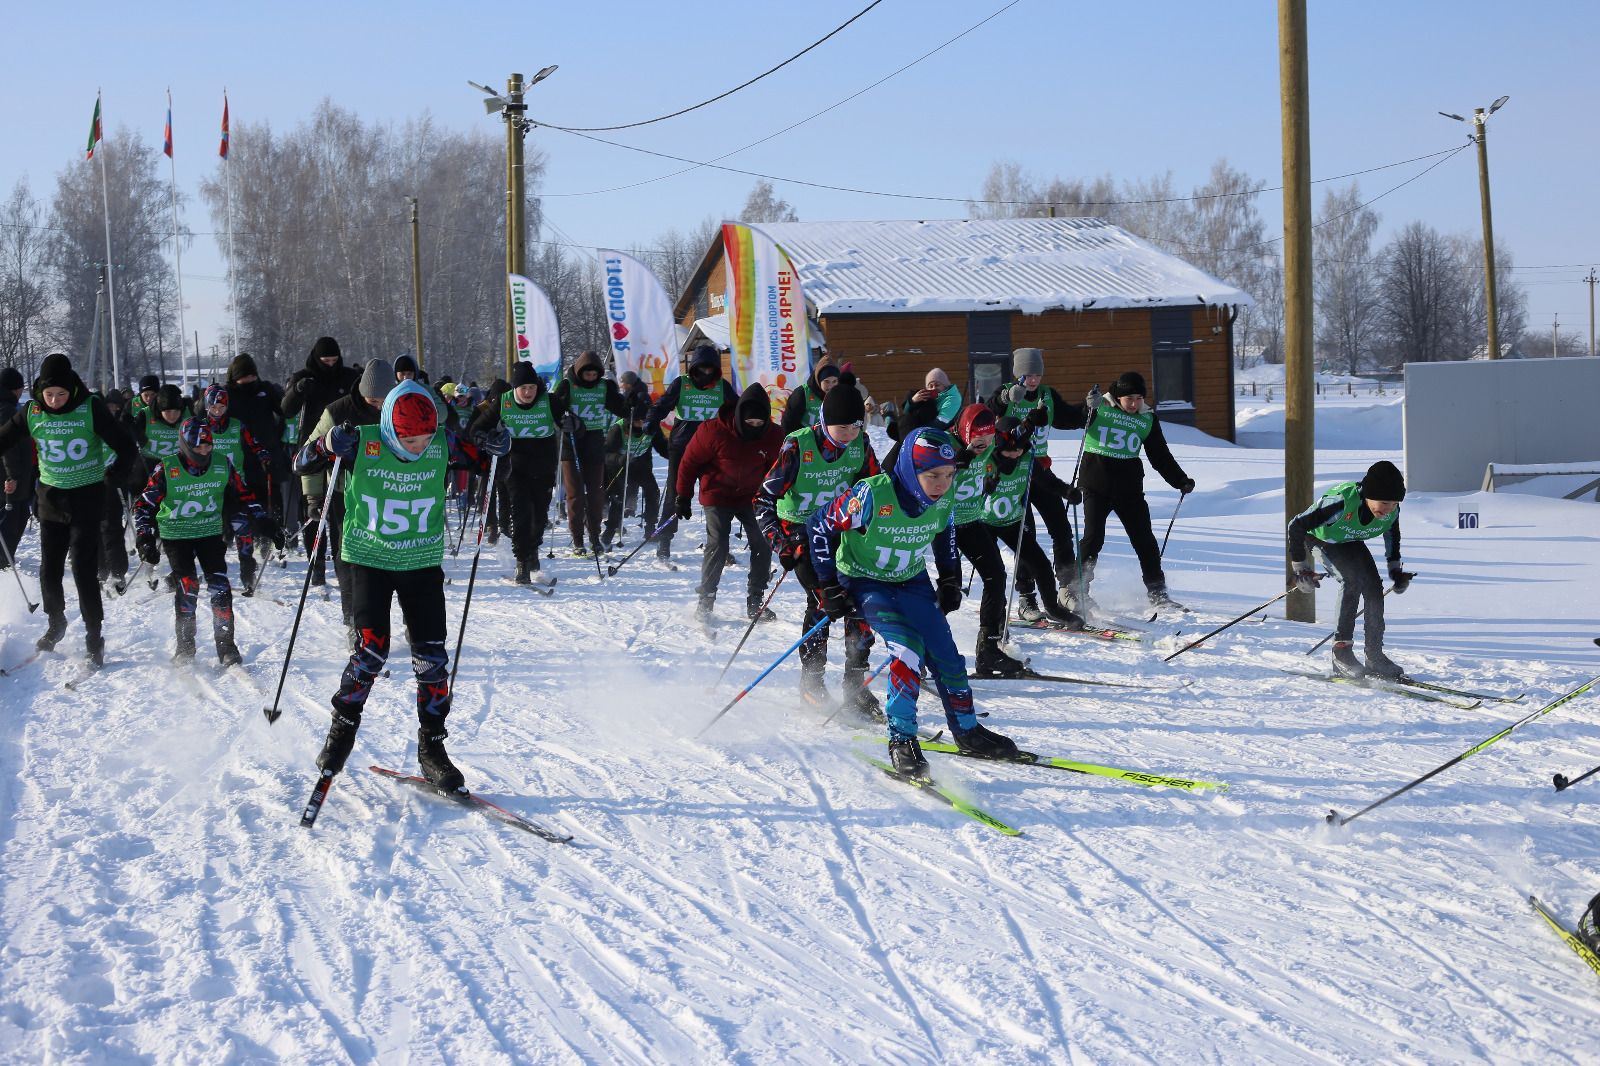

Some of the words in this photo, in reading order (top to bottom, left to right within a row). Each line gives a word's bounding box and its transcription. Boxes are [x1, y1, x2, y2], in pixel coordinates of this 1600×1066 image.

[606, 259, 626, 321] СПОРТ!
[778, 271, 792, 317] ЯРЧЕ!
[513, 282, 526, 335] СПОРТ!
[767, 285, 777, 327] СПОРТОМ
[519, 350, 530, 358] Я
[613, 341, 631, 351] Я
[780, 323, 796, 373] СТАНЬ
[682, 405, 720, 421] 137
[1104, 411, 1147, 429] ТУКАЕВСКИЙ
[1113, 419, 1137, 429] РАЙОН
[1097, 426, 1141, 453] 130
[37, 438, 88, 463] 150
[366, 468, 437, 483] ТУКАЕВСКИЙ
[383, 481, 422, 493] РАЙОН
[361, 494, 436, 535] 157
[1460, 513, 1478, 528] 10
[893, 533, 930, 544] РАЙОН
[1121, 772, 1195, 789] FISCHER
